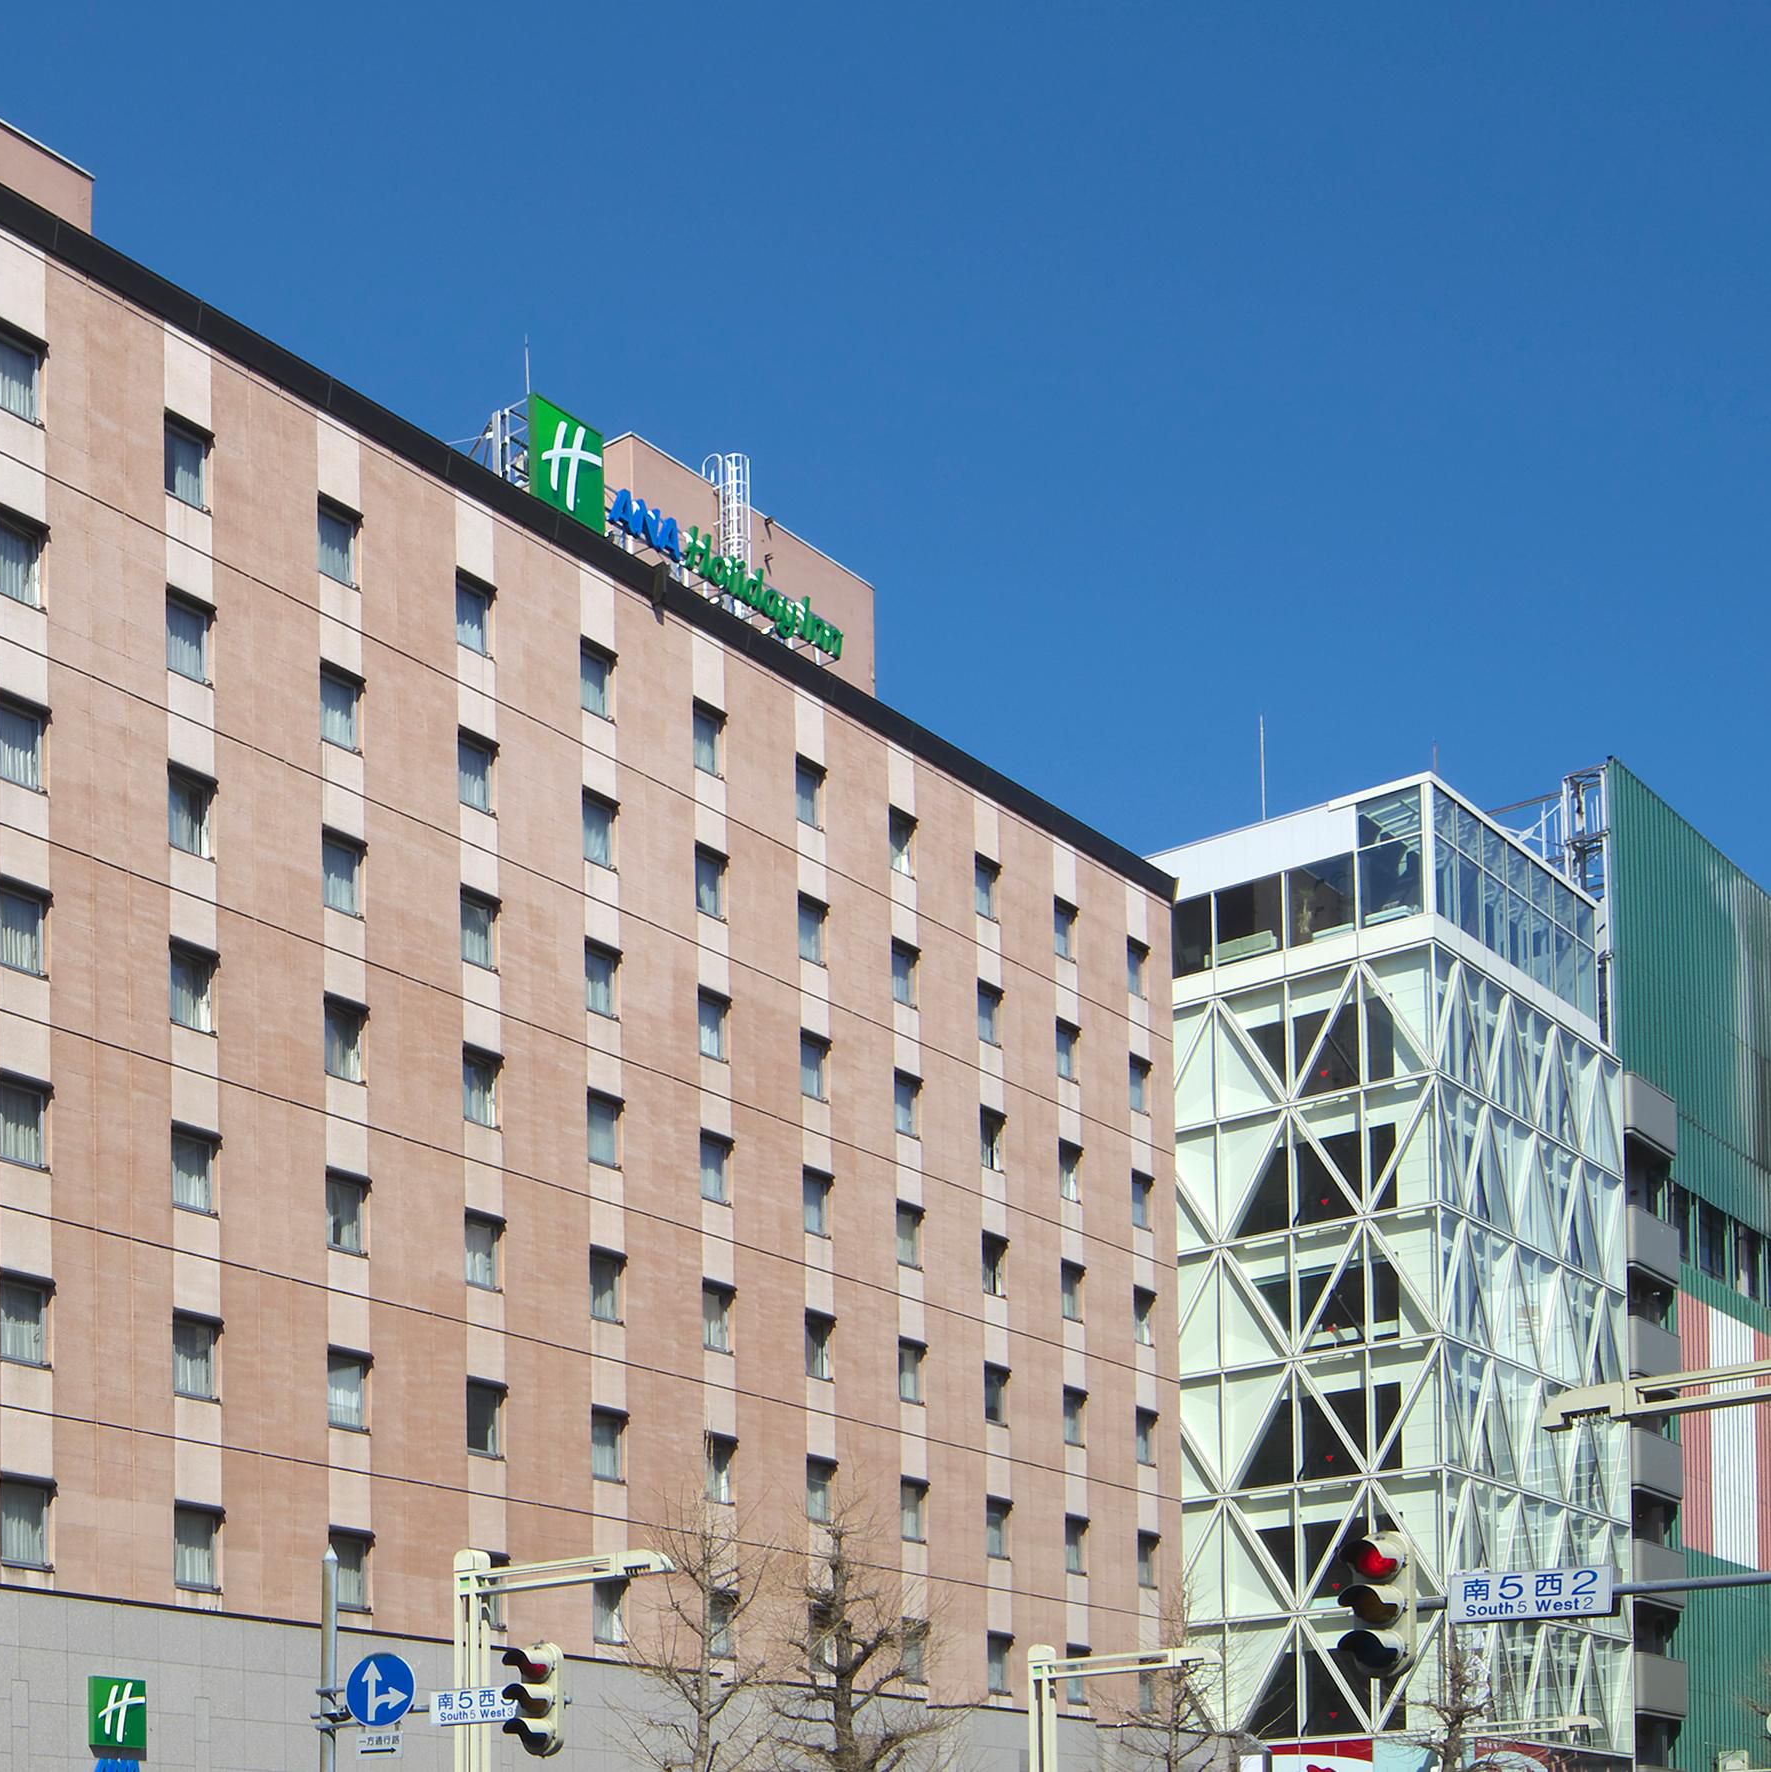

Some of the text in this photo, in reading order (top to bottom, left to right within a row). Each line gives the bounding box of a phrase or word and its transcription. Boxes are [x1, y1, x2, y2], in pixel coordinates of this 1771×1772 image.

[608, 488, 844, 661] ANA Holiday Inn
[1465, 1602, 1514, 1617] South
[1535, 1597, 1580, 1612] West
[440, 1710, 469, 1722] South
[480, 1708, 506, 1719] West
